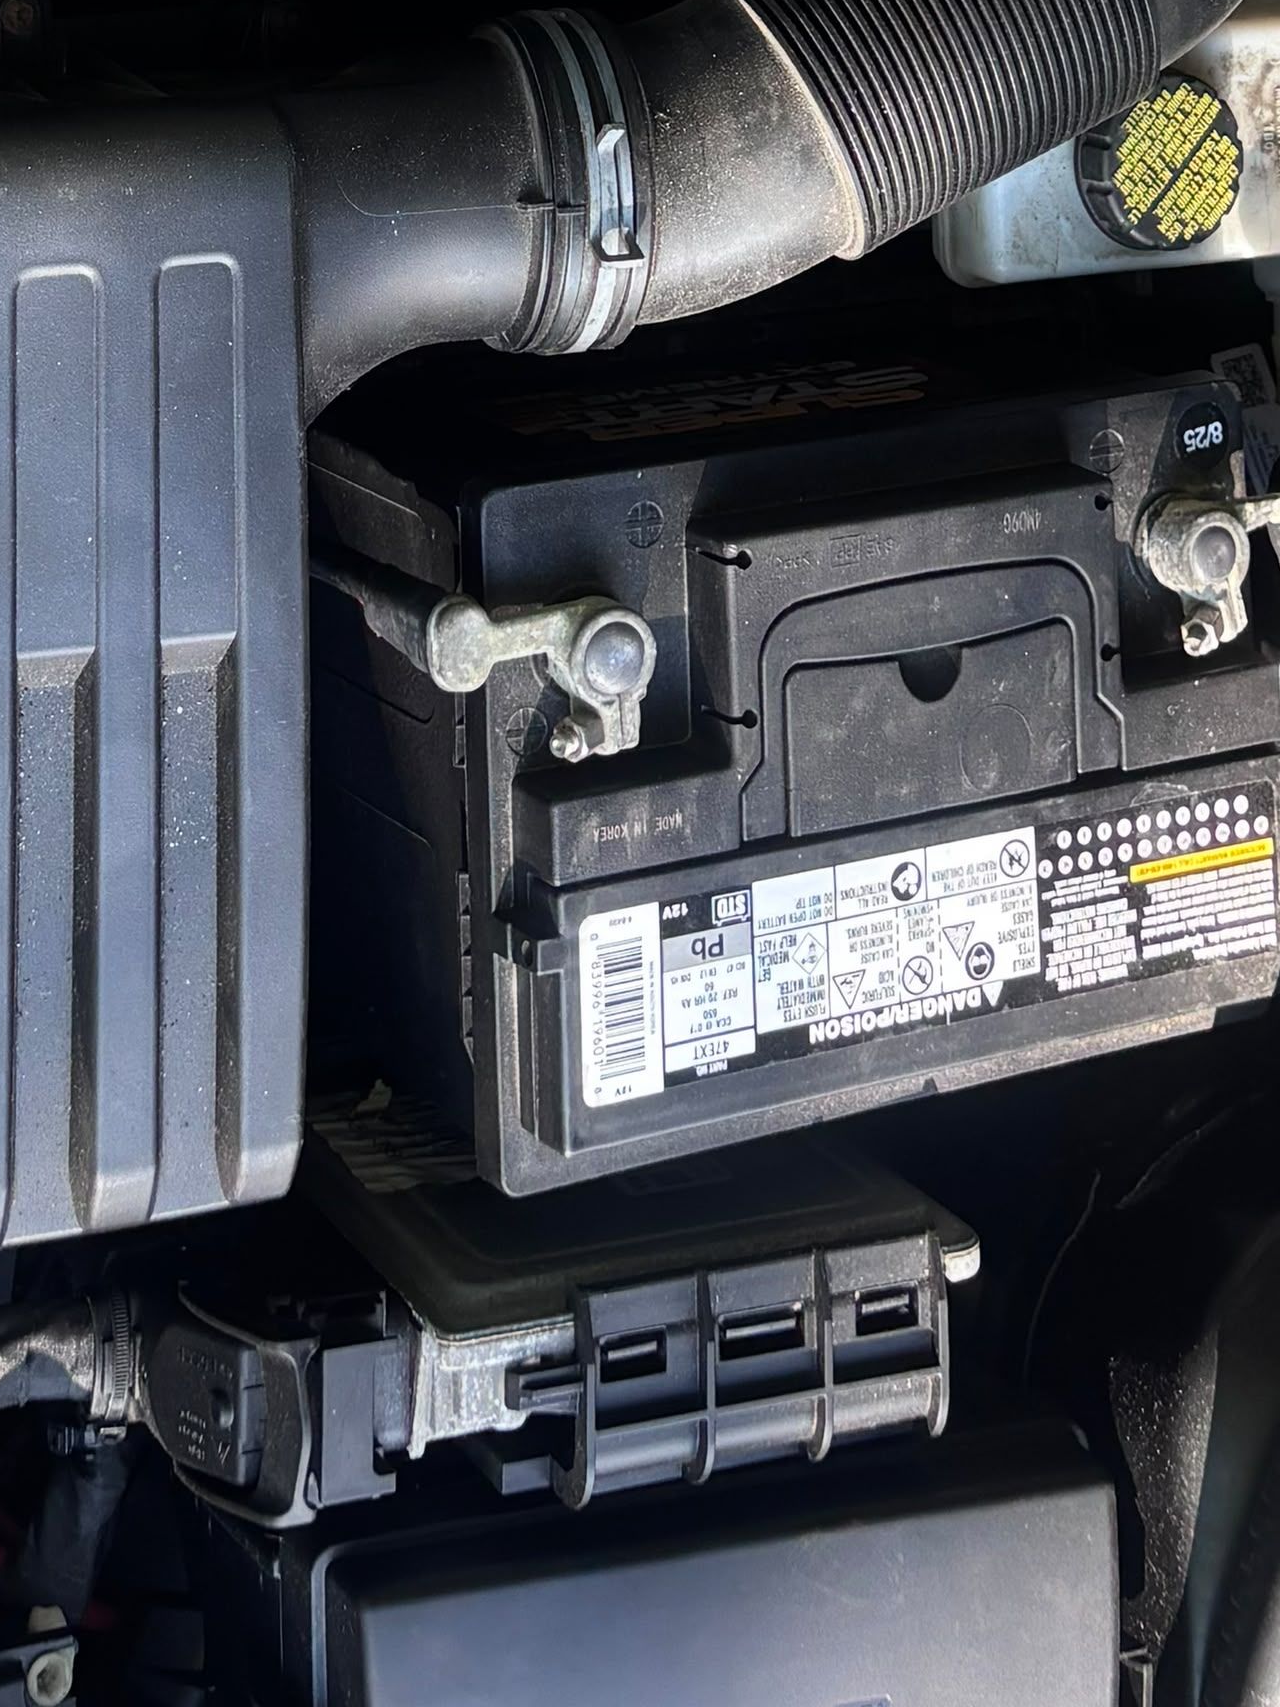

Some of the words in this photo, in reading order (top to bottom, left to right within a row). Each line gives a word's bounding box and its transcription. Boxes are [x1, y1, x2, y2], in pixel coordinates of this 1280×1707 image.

[1161, 82, 1191, 116] LIQUIDE
[1113, 108, 1156, 161] CONTENANT
[1159, 130, 1186, 161] AVANT
[1209, 129, 1222, 140] A
[1209, 134, 1232, 159] ONLY
[1109, 135, 1152, 188] PROVENANT
[1149, 158, 1165, 173] DE
[1187, 135, 1217, 171] SEALED
[1197, 156, 1216, 176] DOT
[1209, 143, 1240, 180] BEFORE
[1128, 160, 1149, 183] QUE
[1141, 169, 1157, 185] LE
[1213, 164, 1239, 194] CLEAN
[1117, 178, 1135, 196] DU
[1136, 168, 1174, 212] NETTOYER
[1173, 180, 1199, 209] FLUID
[1126, 208, 1143, 225] LE
[1154, 205, 1181, 234] FROM
[1192, 190, 1221, 224] FILLER
[1164, 221, 1184, 242] USE
[1180, 220, 1199, 241] CAP
[1181, 422, 1224, 451] 8/25
[591, 821, 629, 842] KOREA
[660, 900, 689, 919] 12V
[713, 893, 746, 918] STD
[689, 932, 726, 961] Pb
[756, 948, 790, 966] MEDICAL
[591, 961, 599, 1009] 83996
[806, 986, 984, 1043] DANGER/POISON
[593, 1020, 603, 1065] 19601
[691, 1039, 730, 1059] 47EXT
